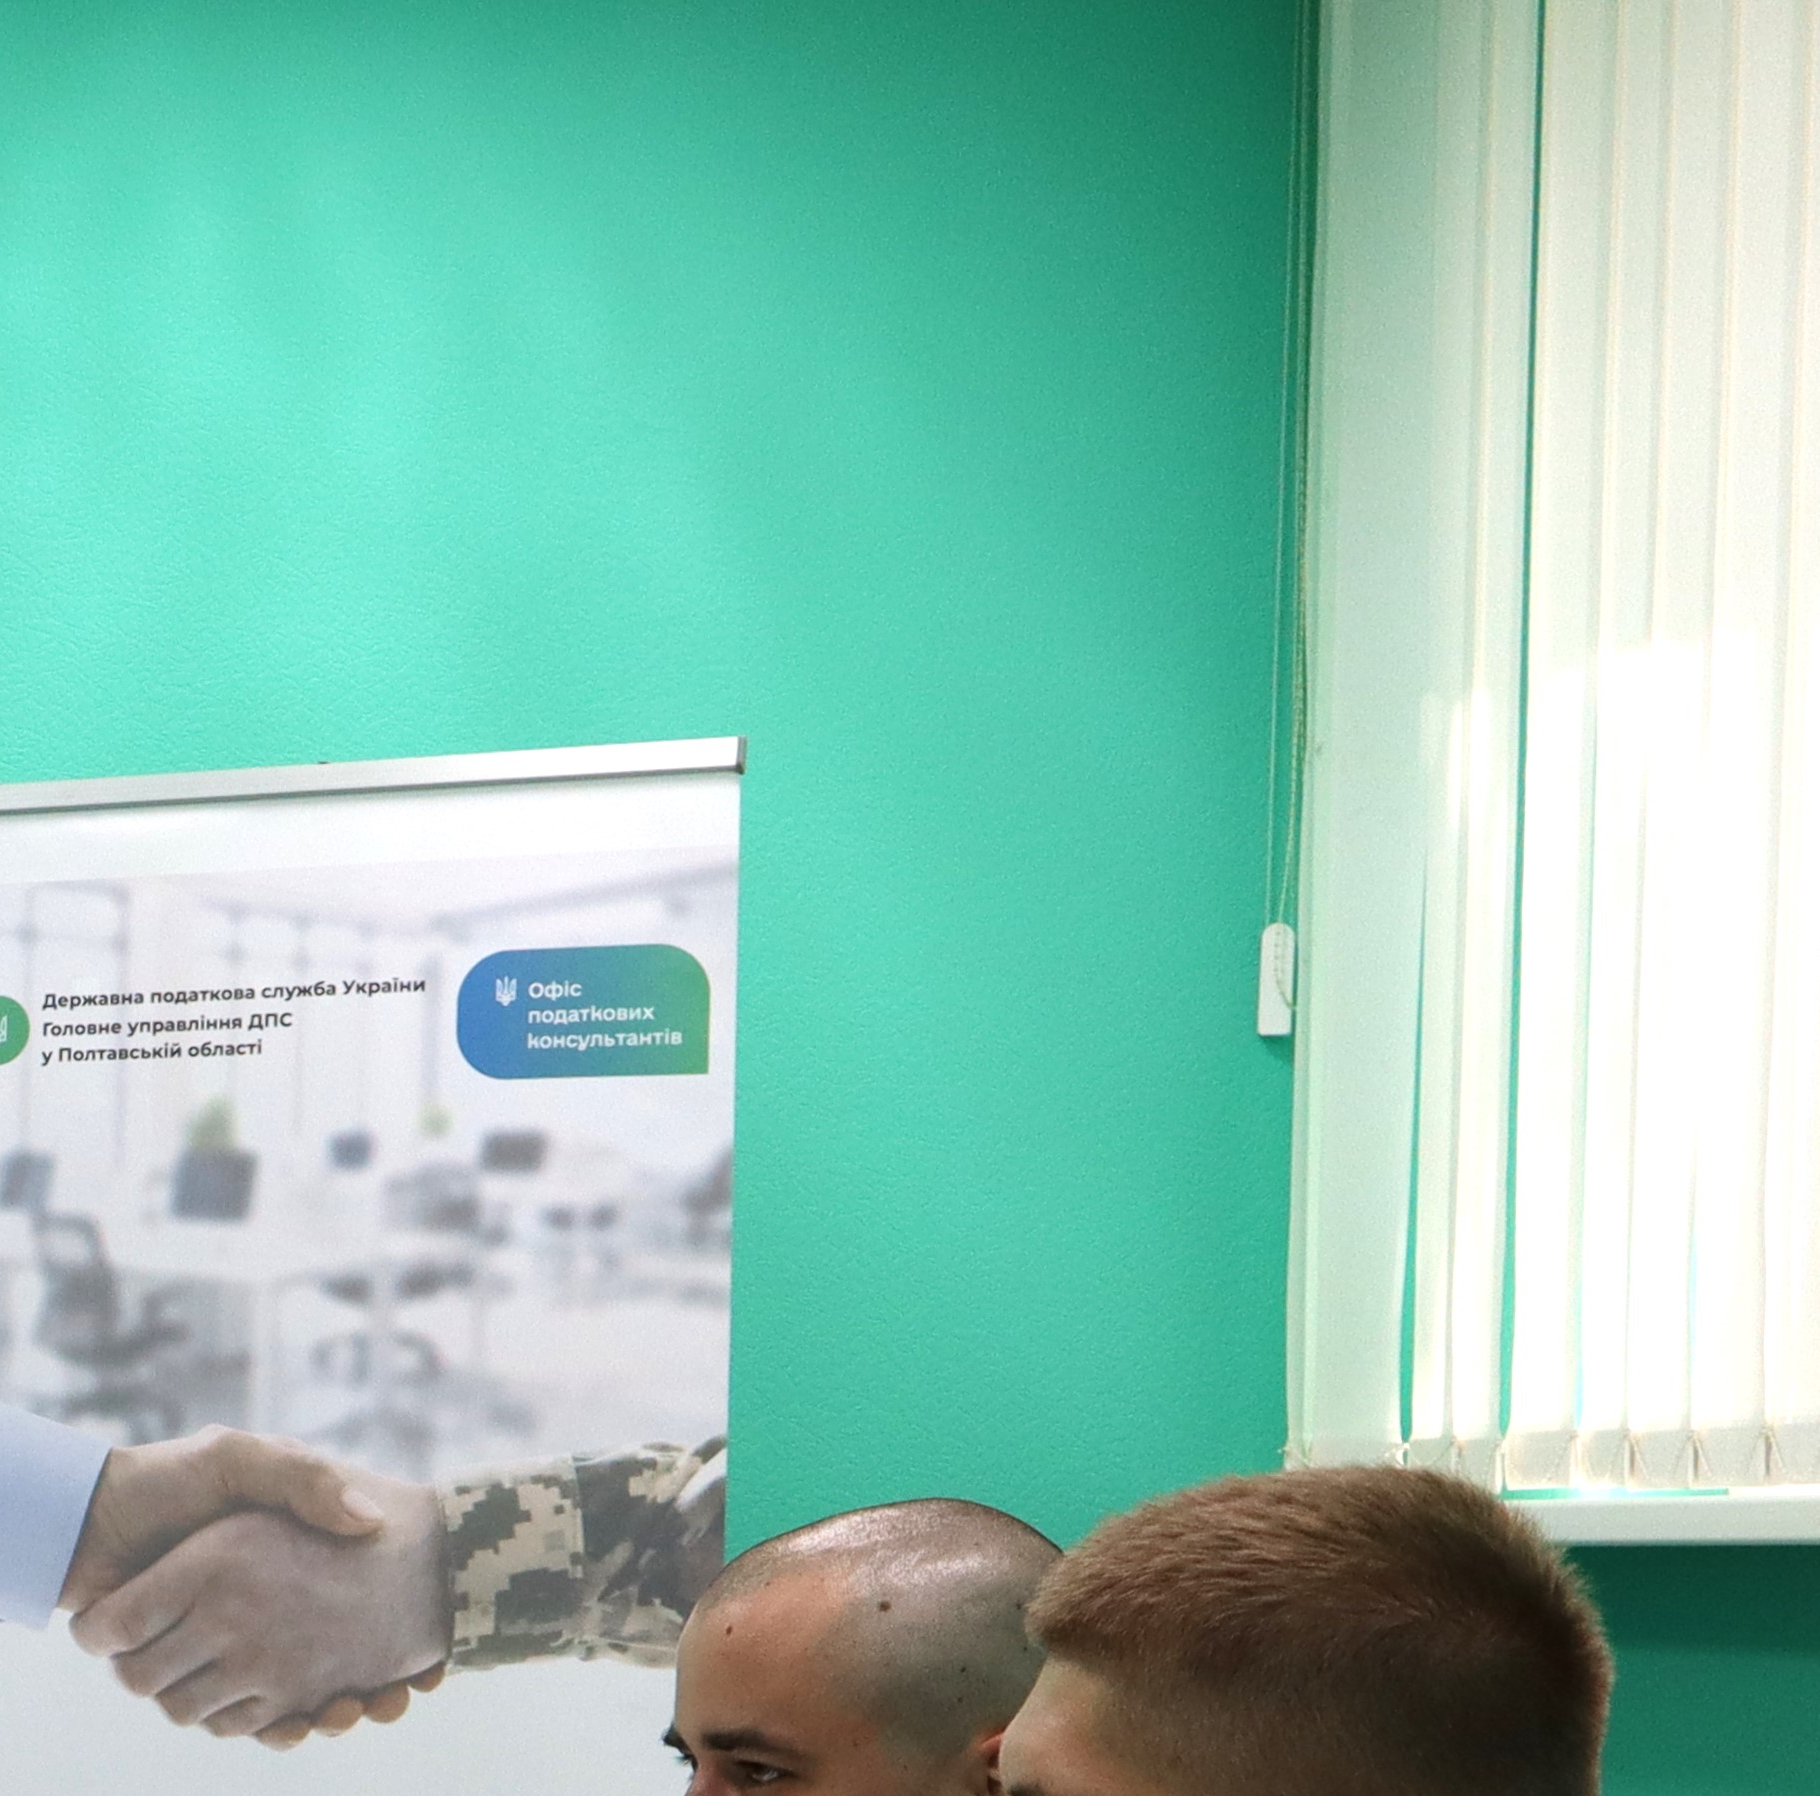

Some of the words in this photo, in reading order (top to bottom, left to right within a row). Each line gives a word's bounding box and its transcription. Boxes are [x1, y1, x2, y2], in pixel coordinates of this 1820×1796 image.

[42, 992, 145, 1011] Державна
[150, 986, 256, 1006] податкова
[261, 980, 337, 1003] служба
[342, 977, 426, 998] України
[528, 980, 582, 1001] Офіс
[42, 1020, 123, 1037] Головне
[127, 1015, 243, 1037] управління
[247, 1012, 293, 1032] ДПС
[528, 1005, 655, 1025] податкових
[527, 1027, 683, 1052] консультантів
[41, 1050, 53, 1067] у
[58, 1042, 182, 1063] Полтавській
[187, 1038, 262, 1059] області
